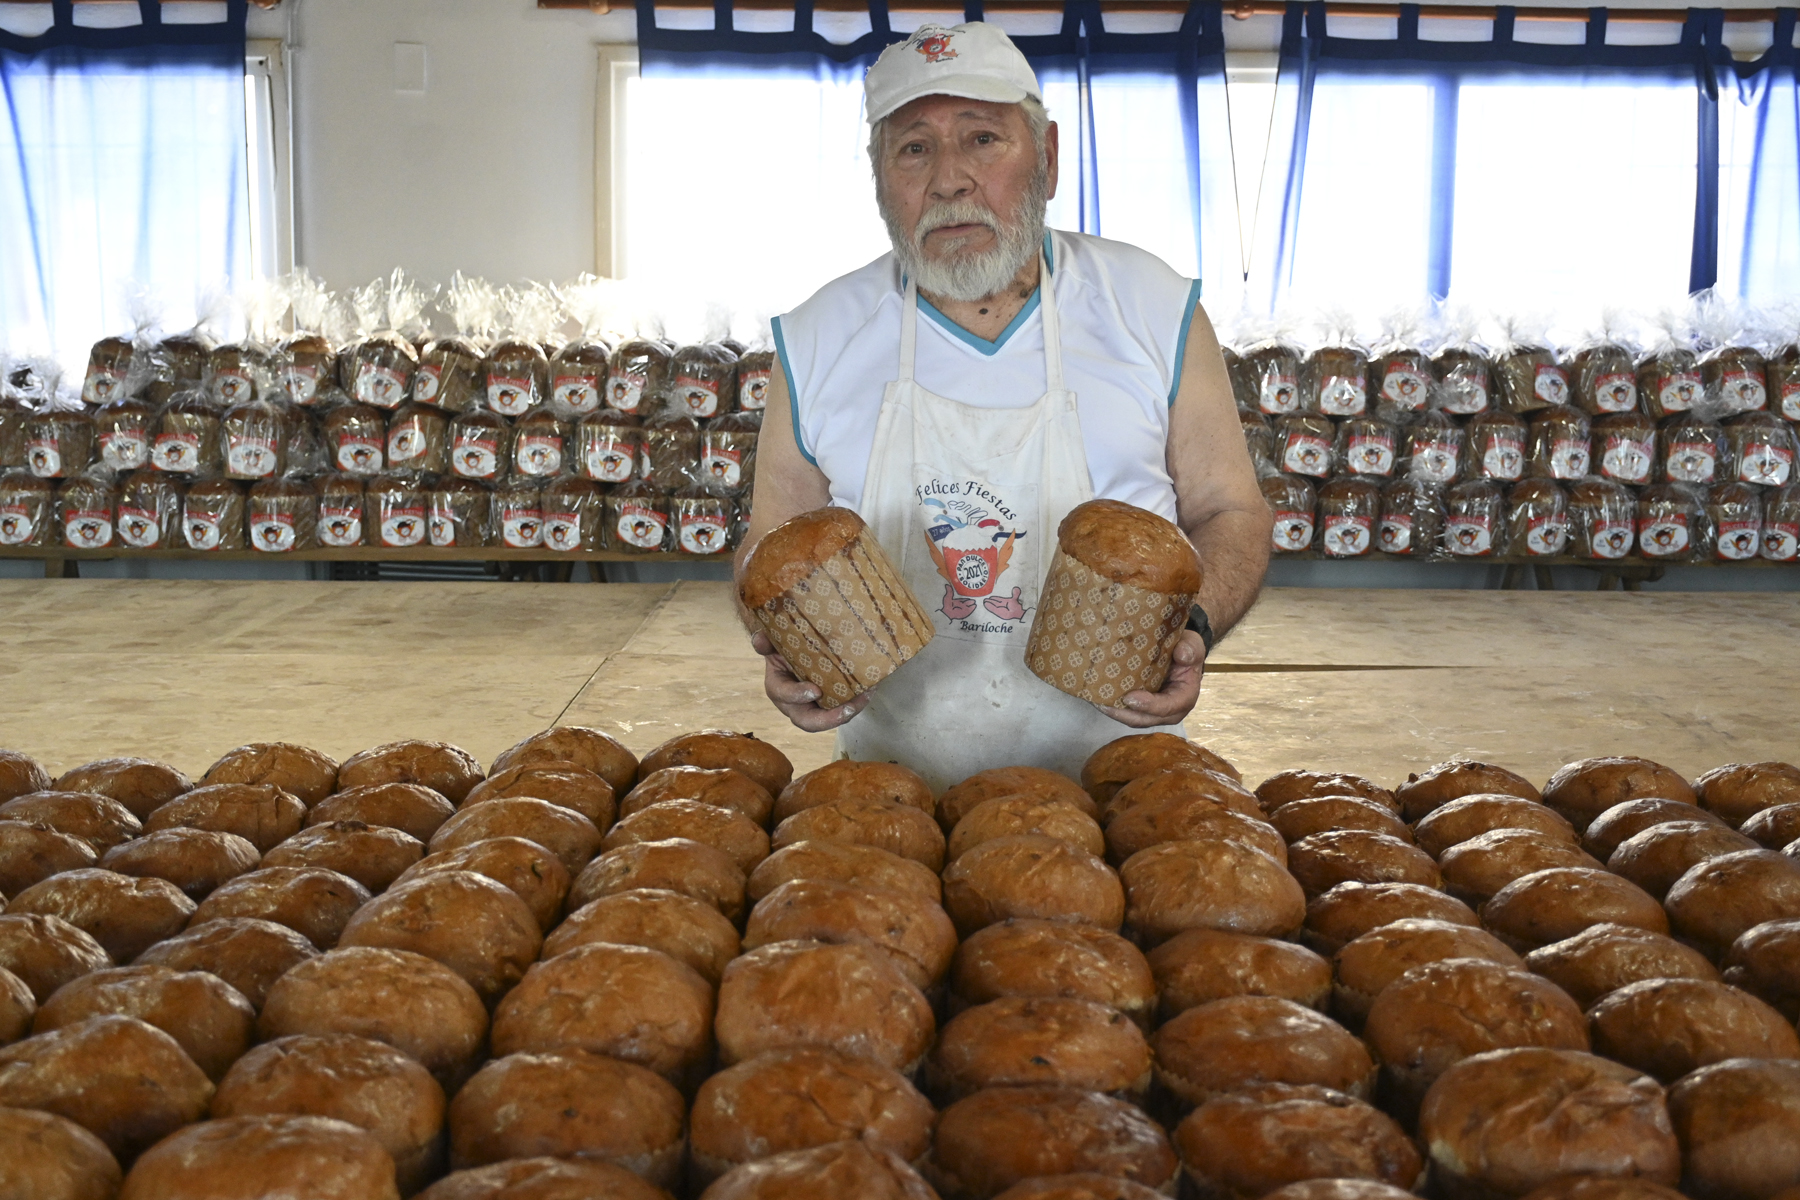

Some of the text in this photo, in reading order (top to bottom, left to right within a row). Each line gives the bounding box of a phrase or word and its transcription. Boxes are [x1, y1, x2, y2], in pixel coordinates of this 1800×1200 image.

[916, 479, 1017, 520] Felices Fiestas
[965, 555, 986, 567] DULCE
[959, 570, 989, 589] SOLIDARIO
[964, 564, 983, 580] 2021
[960, 620, 1013, 634] Bariloche
